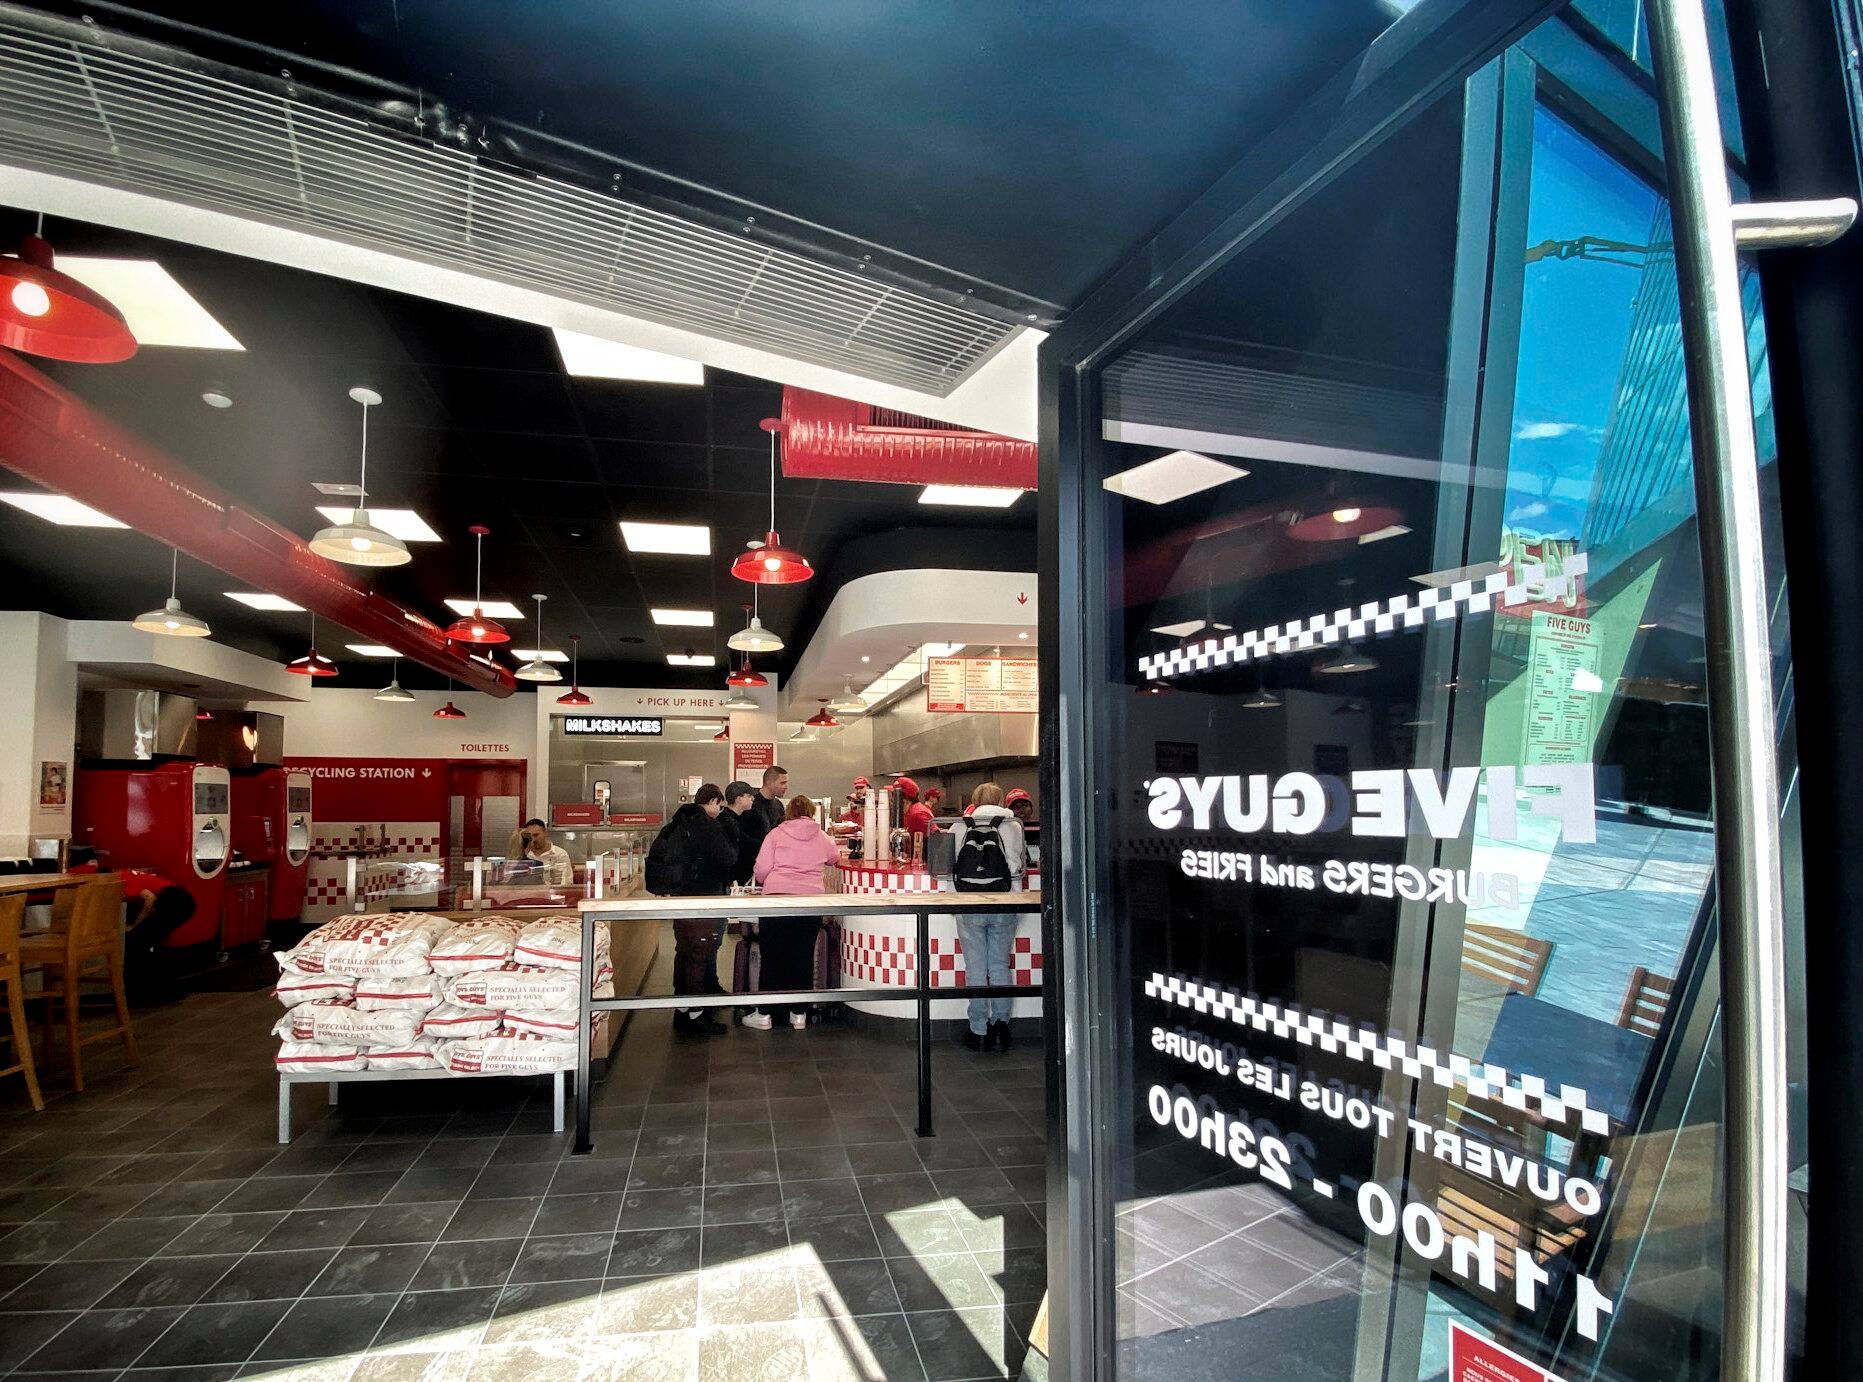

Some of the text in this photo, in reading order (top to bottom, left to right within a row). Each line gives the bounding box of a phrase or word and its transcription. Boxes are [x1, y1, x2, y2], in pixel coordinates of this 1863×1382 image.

[1547, 616, 1591, 635] FIVE GUYS
[647, 697, 715, 707] PICK UP HERE
[566, 719, 661, 732] MILKSHAKES
[460, 743, 510, 752] TOILETTES
[359, 767, 415, 779] STATION
[490, 986, 528, 994] SPECIALLY
[317, 1023, 357, 1031] SPECIALLY
[317, 1030, 333, 1038] FOR
[486, 1055, 524, 1063] SPECIALLY
[1474, 1355, 1520, 1382] ALLERGIES
